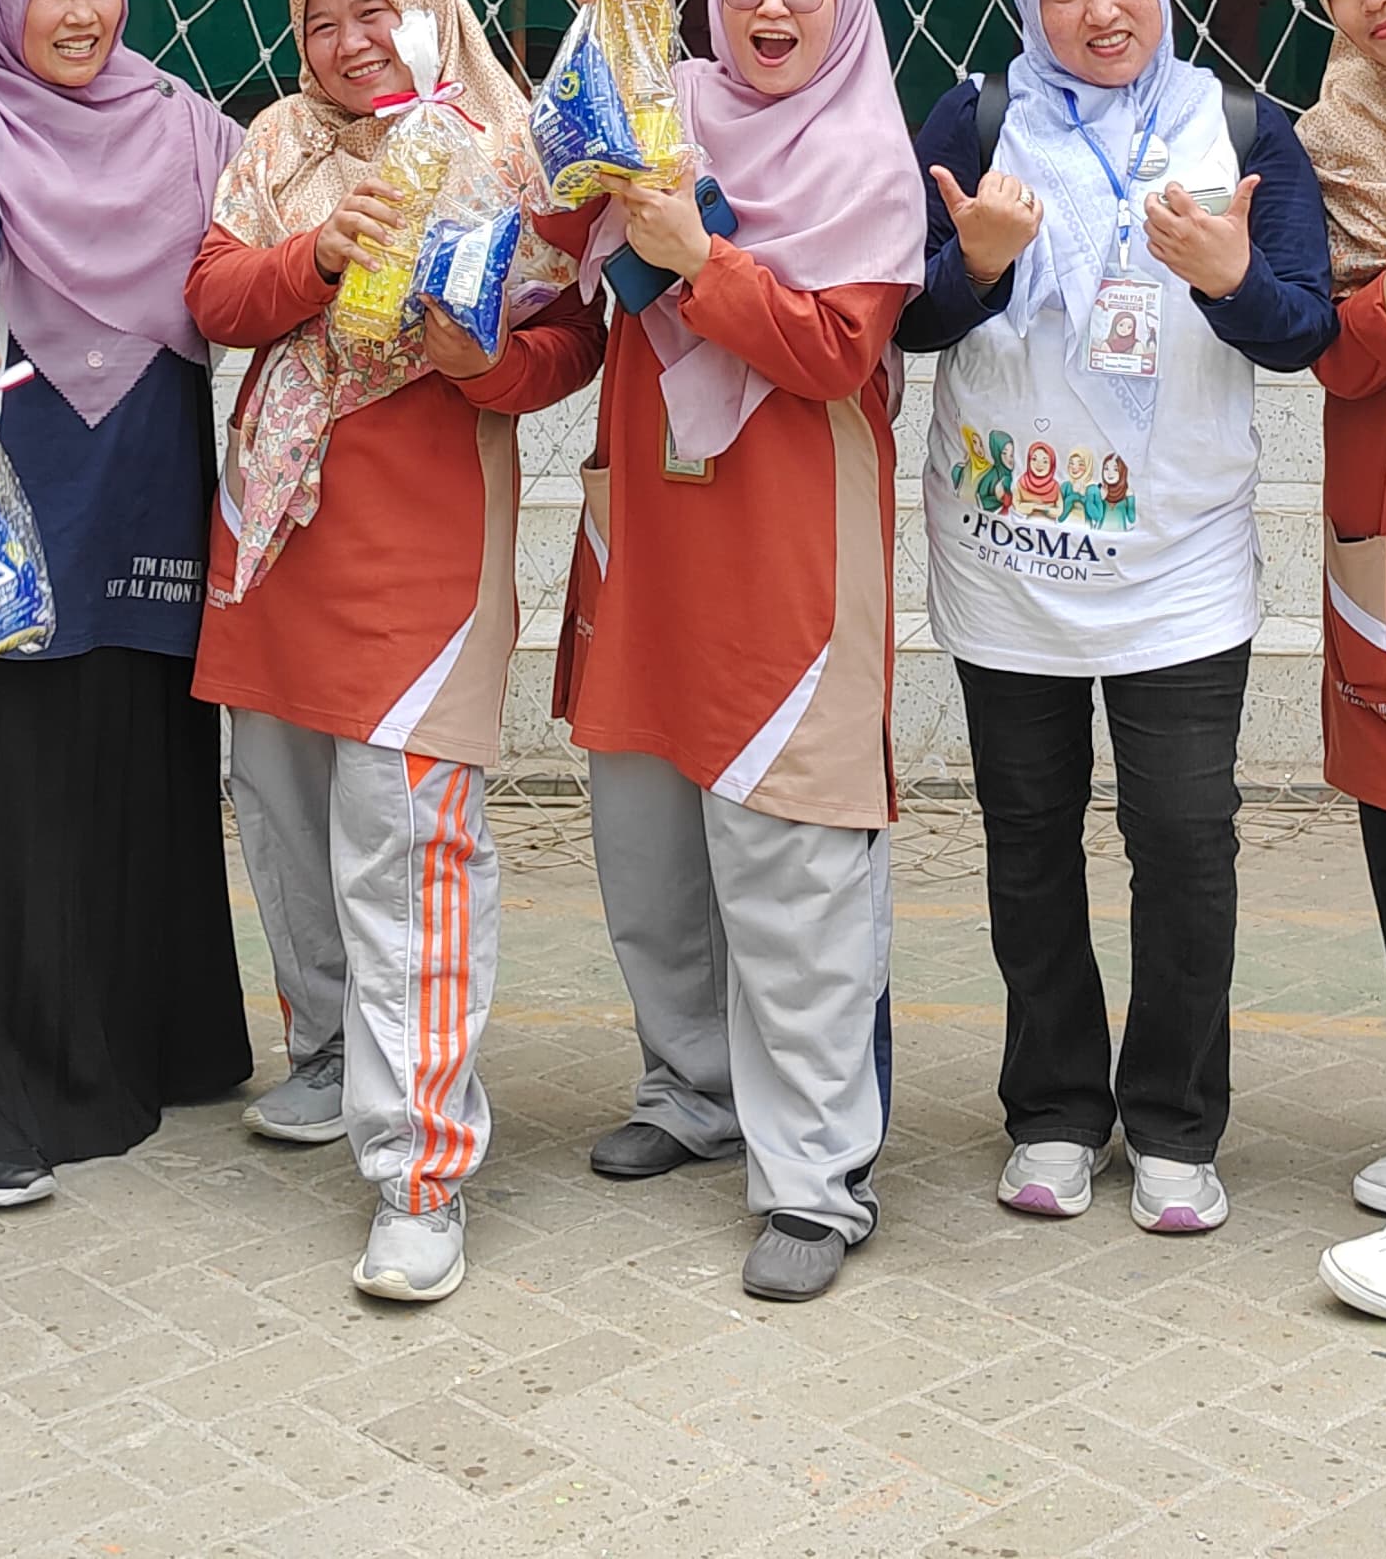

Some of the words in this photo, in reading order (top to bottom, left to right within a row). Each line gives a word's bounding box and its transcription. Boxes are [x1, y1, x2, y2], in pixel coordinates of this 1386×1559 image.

[971, 512, 1100, 562] FOSMA
[132, 556, 158, 576] TIM
[977, 545, 1001, 566] SIT
[1003, 554, 1023, 573] AL
[1029, 560, 1088, 582] ITQON
[105, 579, 127, 598] SIT
[127, 579, 145, 598] AL
[148, 581, 193, 603] ITQON
